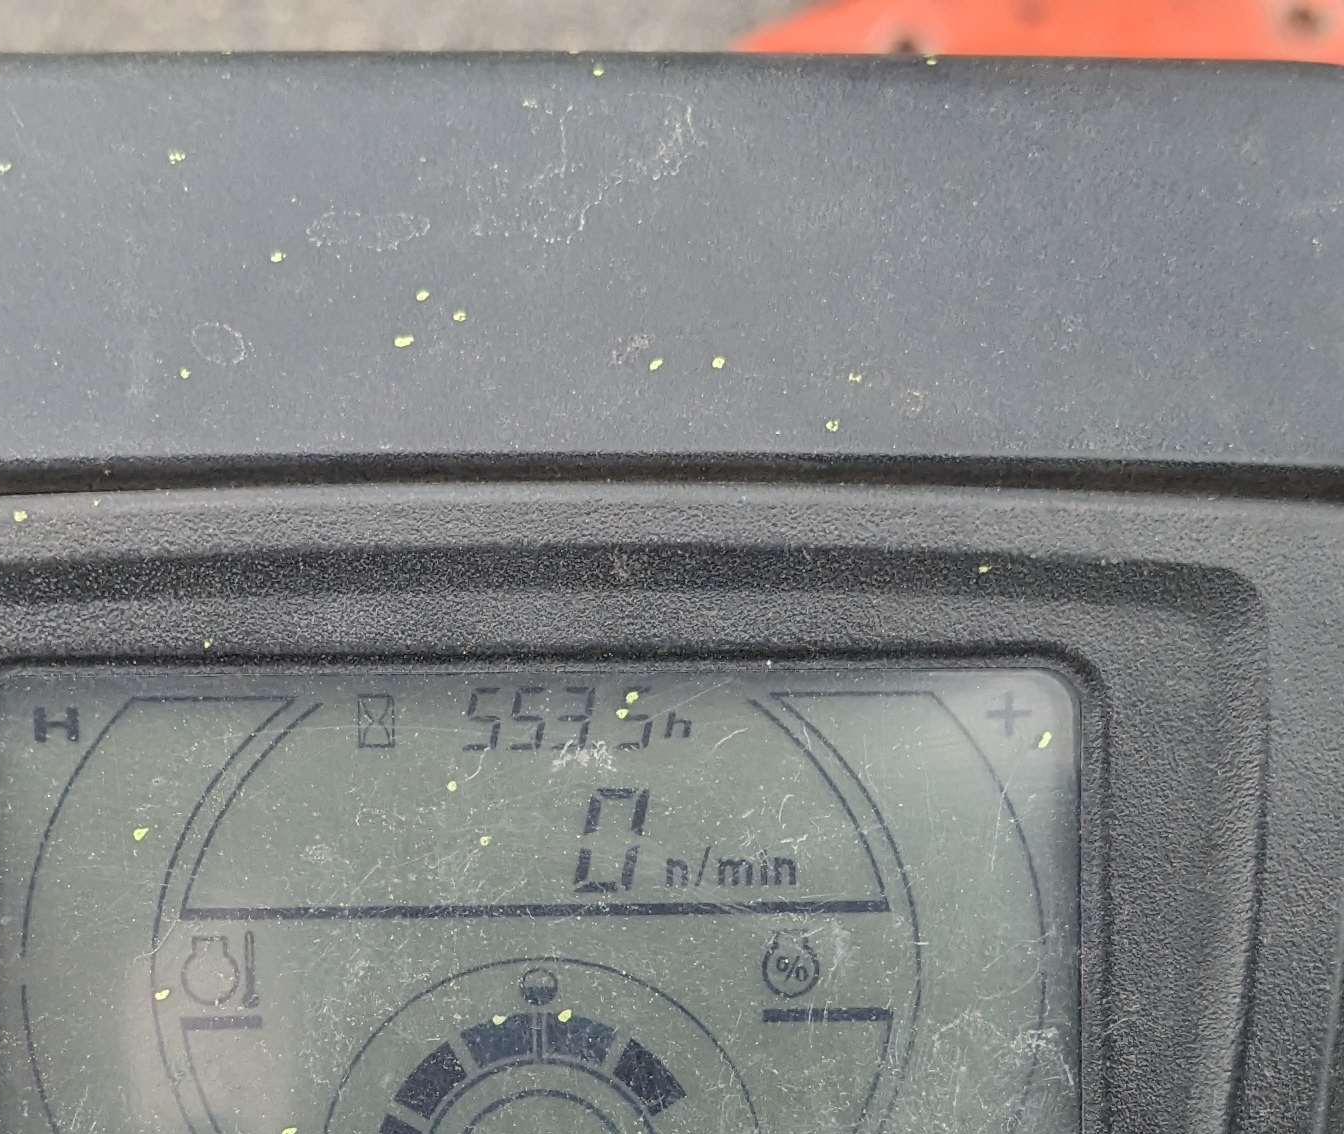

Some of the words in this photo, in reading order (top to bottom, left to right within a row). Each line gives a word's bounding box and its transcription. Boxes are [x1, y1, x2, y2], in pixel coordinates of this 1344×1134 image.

[34, 707, 80, 742] H
[573, 788, 650, 893] 0
[666, 847, 797, 888] n/min
